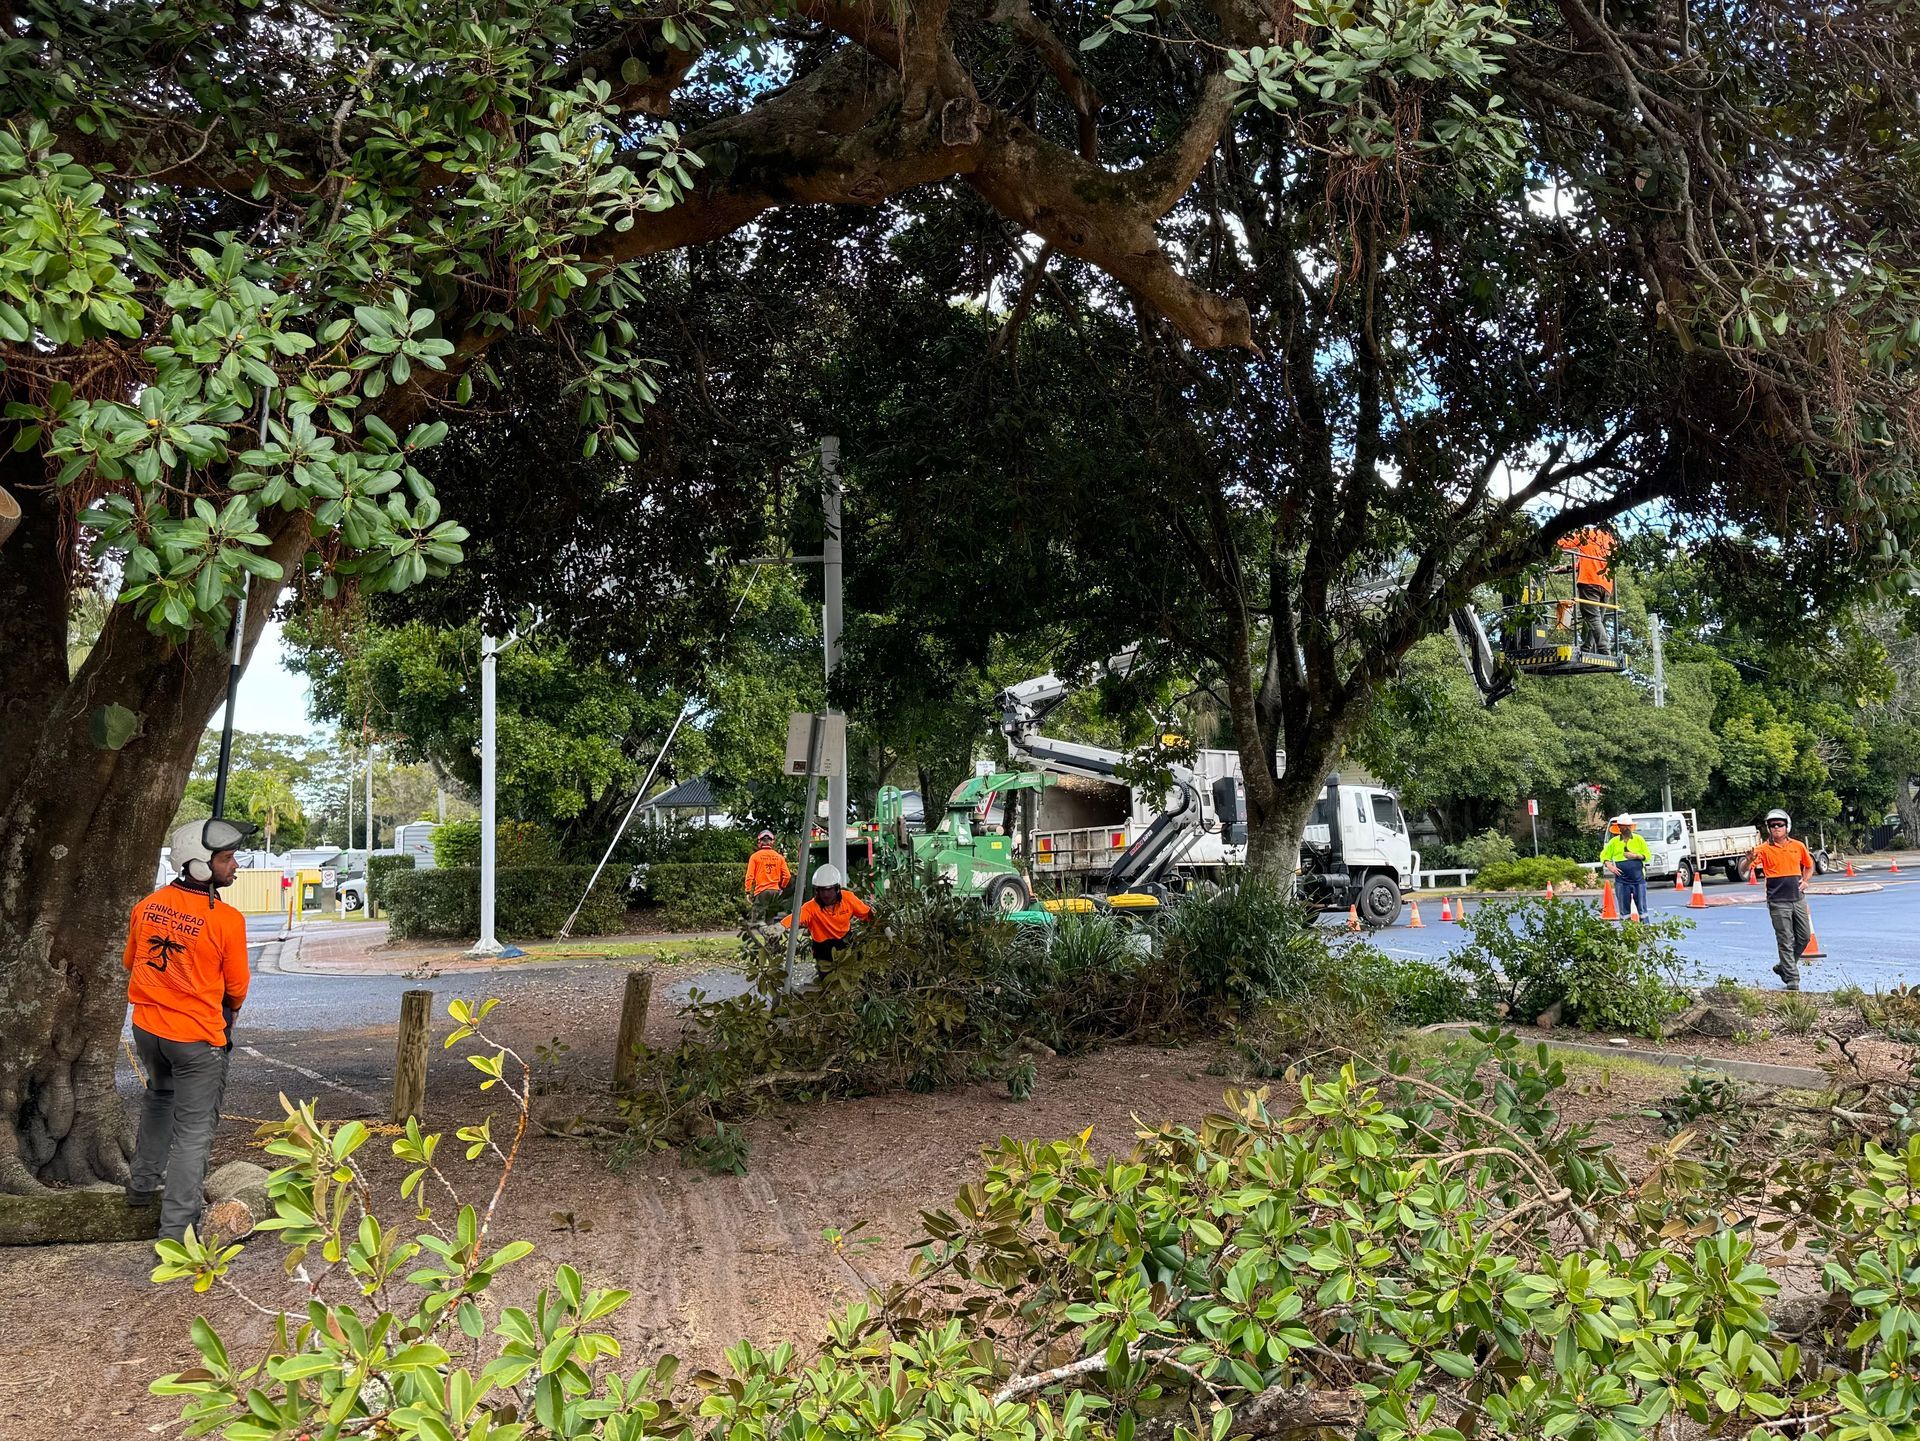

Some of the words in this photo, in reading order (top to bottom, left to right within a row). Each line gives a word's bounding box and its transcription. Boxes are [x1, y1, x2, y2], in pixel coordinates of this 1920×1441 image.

[142, 911, 170, 926] TREE
[170, 920, 200, 937] CARE
[145, 903, 179, 918] LENNOX
[179, 913, 205, 926] HEAD
